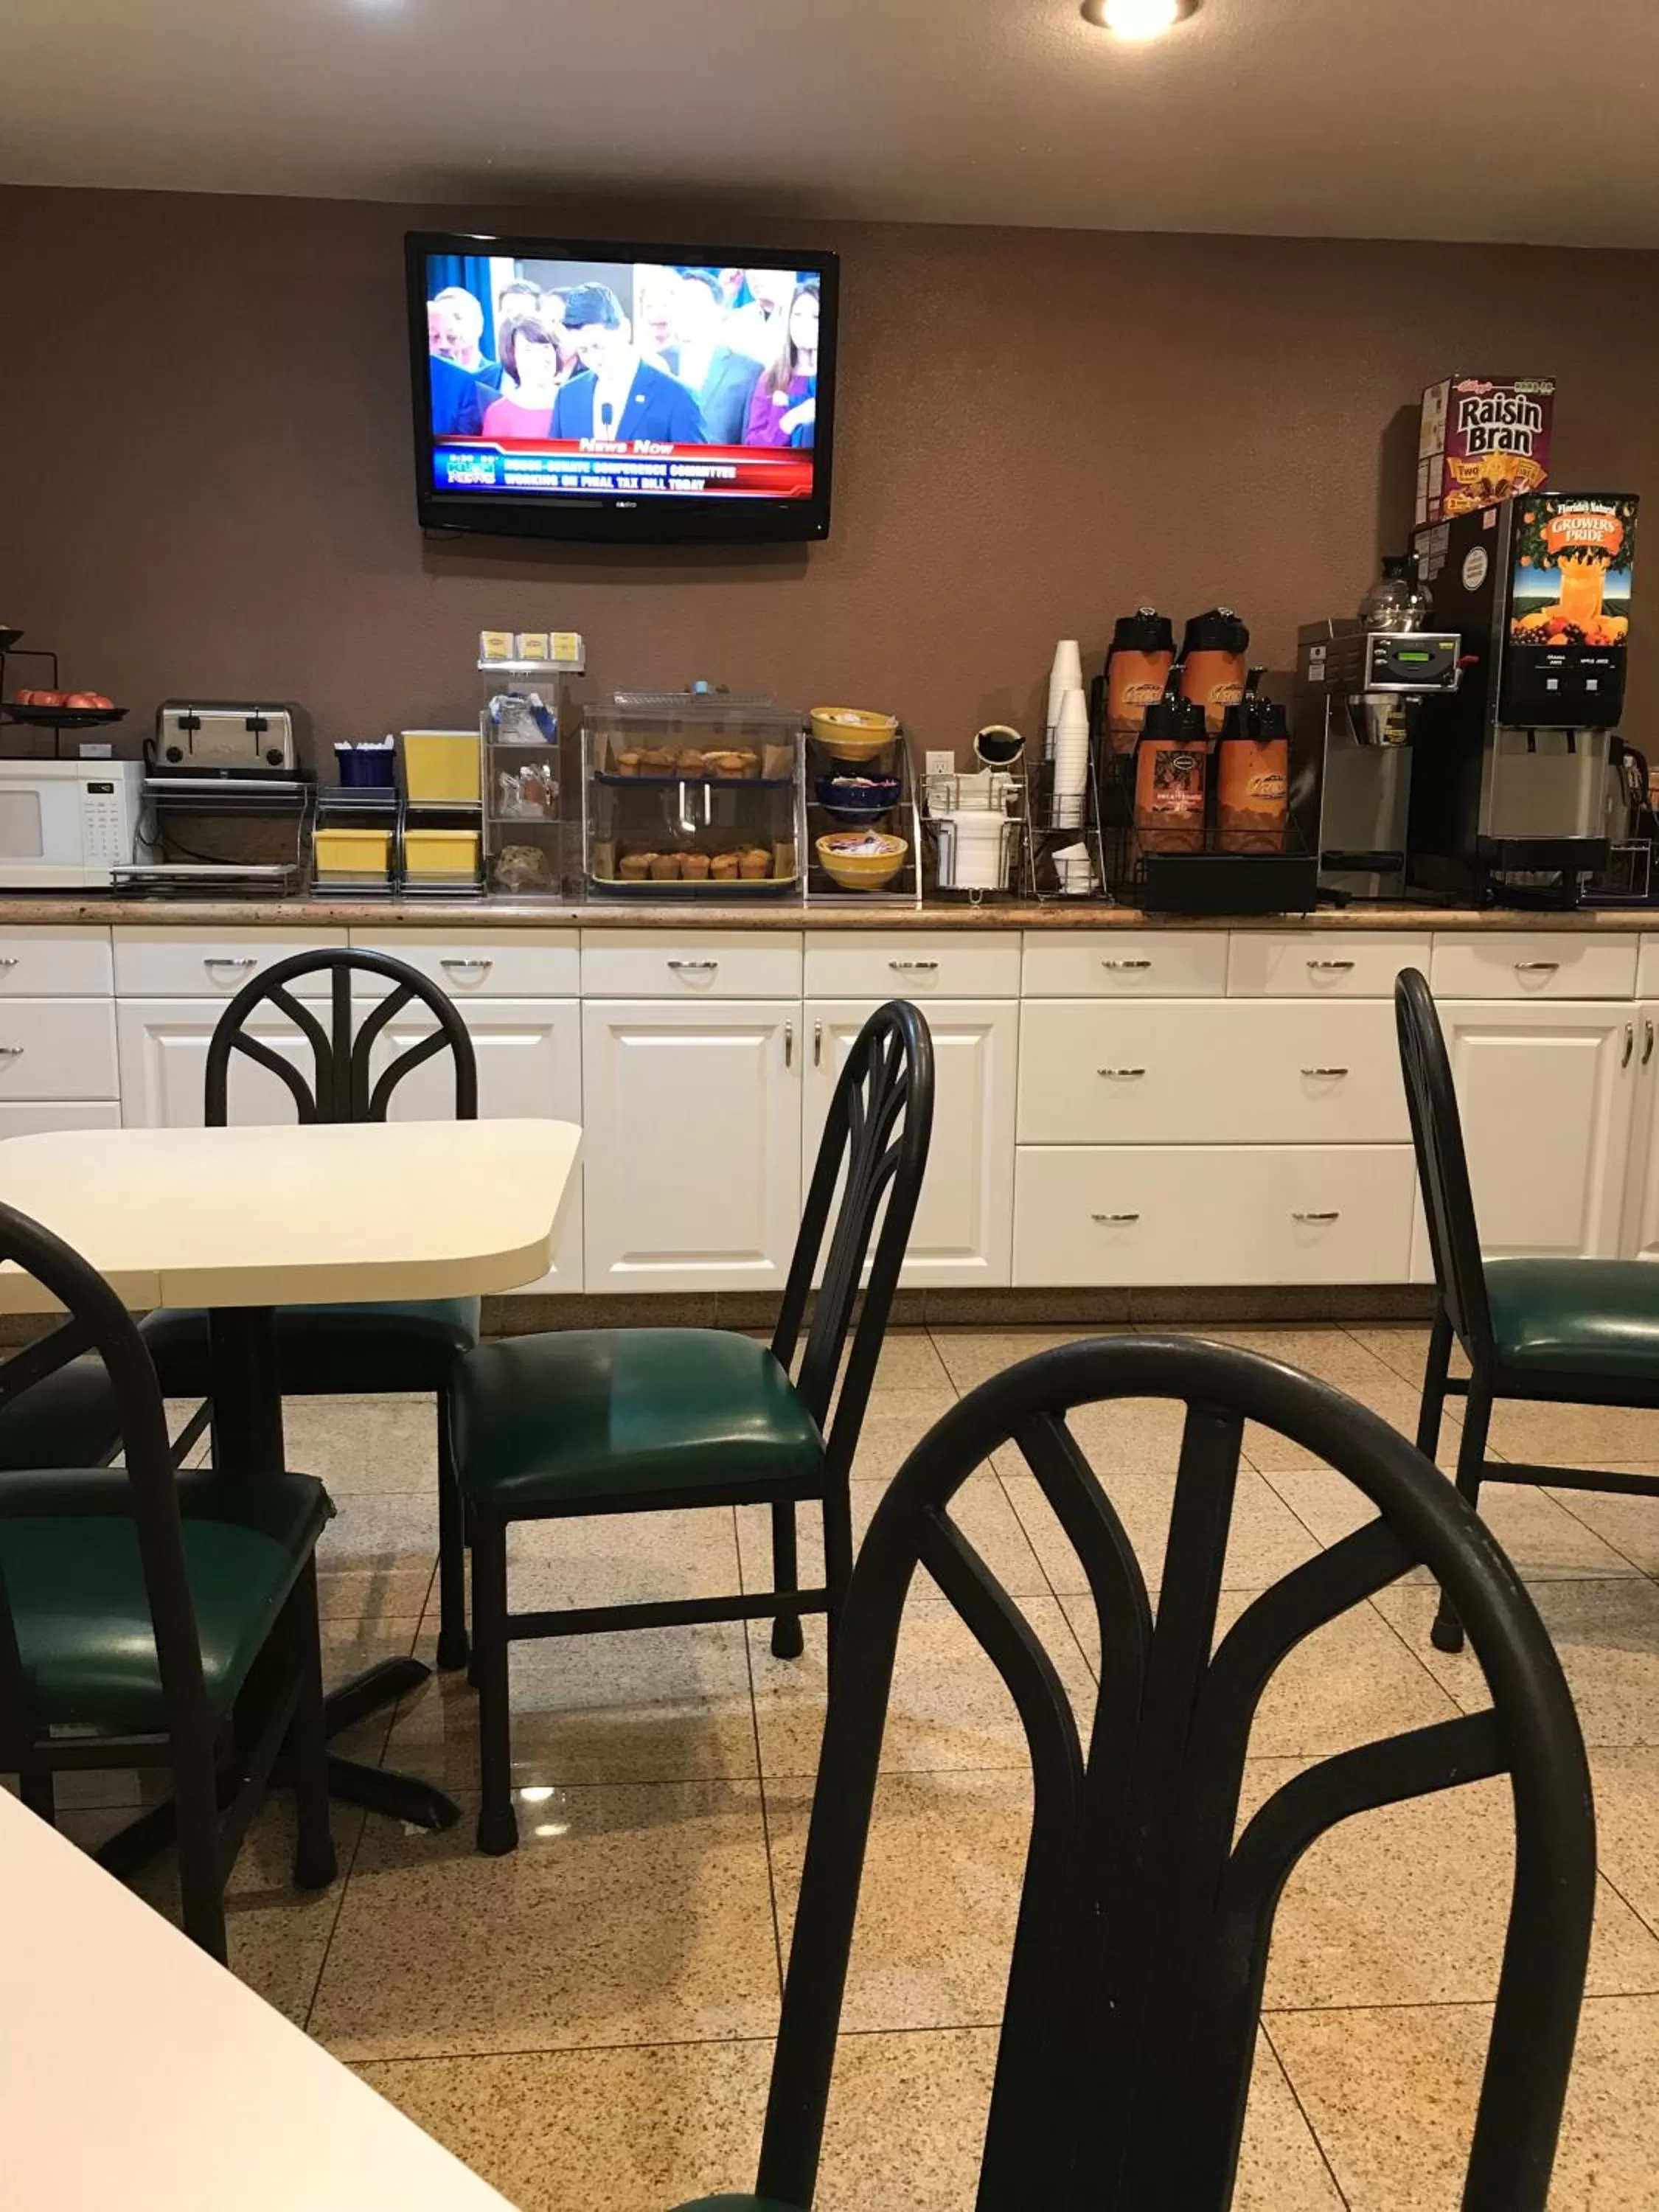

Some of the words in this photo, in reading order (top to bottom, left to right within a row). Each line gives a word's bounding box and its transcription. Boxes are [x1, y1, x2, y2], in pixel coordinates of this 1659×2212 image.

[1459, 393, 1541, 431] Raisin
[579, 437, 627, 453] News
[633, 440, 675, 455] Now
[1467, 425, 1532, 455] Bran
[669, 464, 737, 479] COMMITTEE
[1458, 465, 1479, 476] Two
[580, 476, 614, 489] FINAL
[616, 477, 639, 489] TAX
[641, 478, 666, 490] BILL
[667, 479, 706, 491] TODAY
[1551, 518, 1615, 533] GROWERS
[1565, 529, 1605, 542] PRIDE
